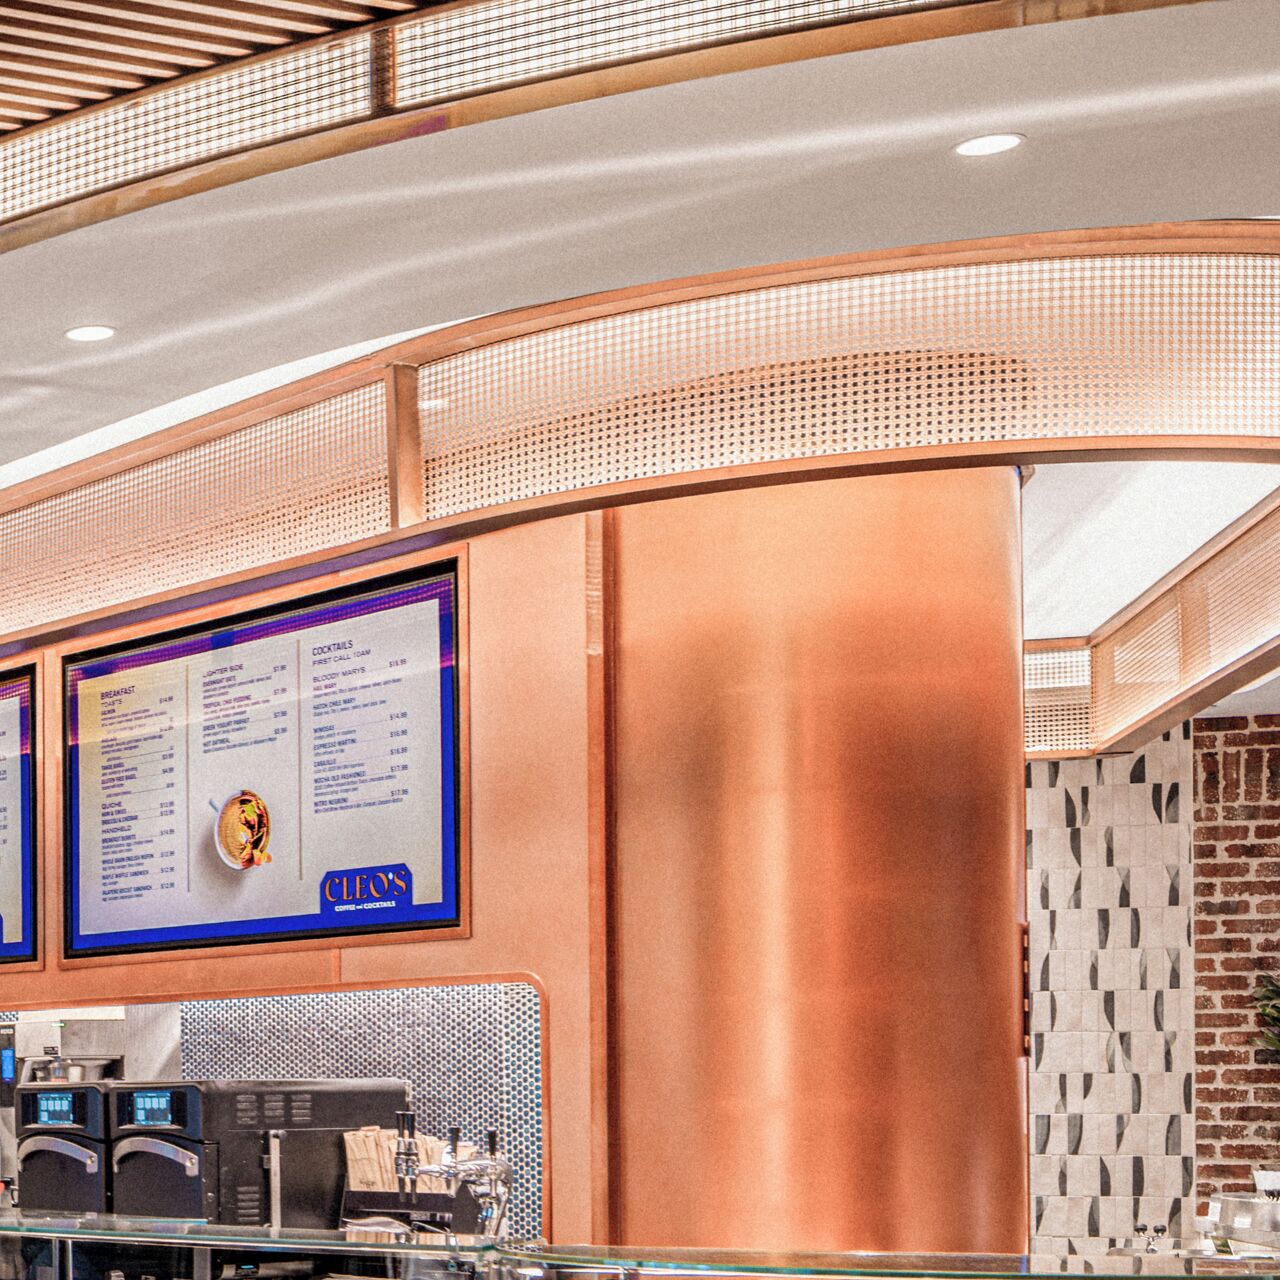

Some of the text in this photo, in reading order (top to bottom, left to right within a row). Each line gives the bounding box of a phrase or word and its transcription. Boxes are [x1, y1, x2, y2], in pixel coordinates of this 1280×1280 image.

[312, 639, 354, 656] COCKTAILS
[333, 653, 351, 663] CALL
[312, 671, 339, 683] BLOODY
[101, 685, 135, 700] BREAKFAST
[324, 870, 408, 903] CLEO'S
[334, 904, 356, 912] COFFEE
[363, 900, 396, 909] COCKTAILS
